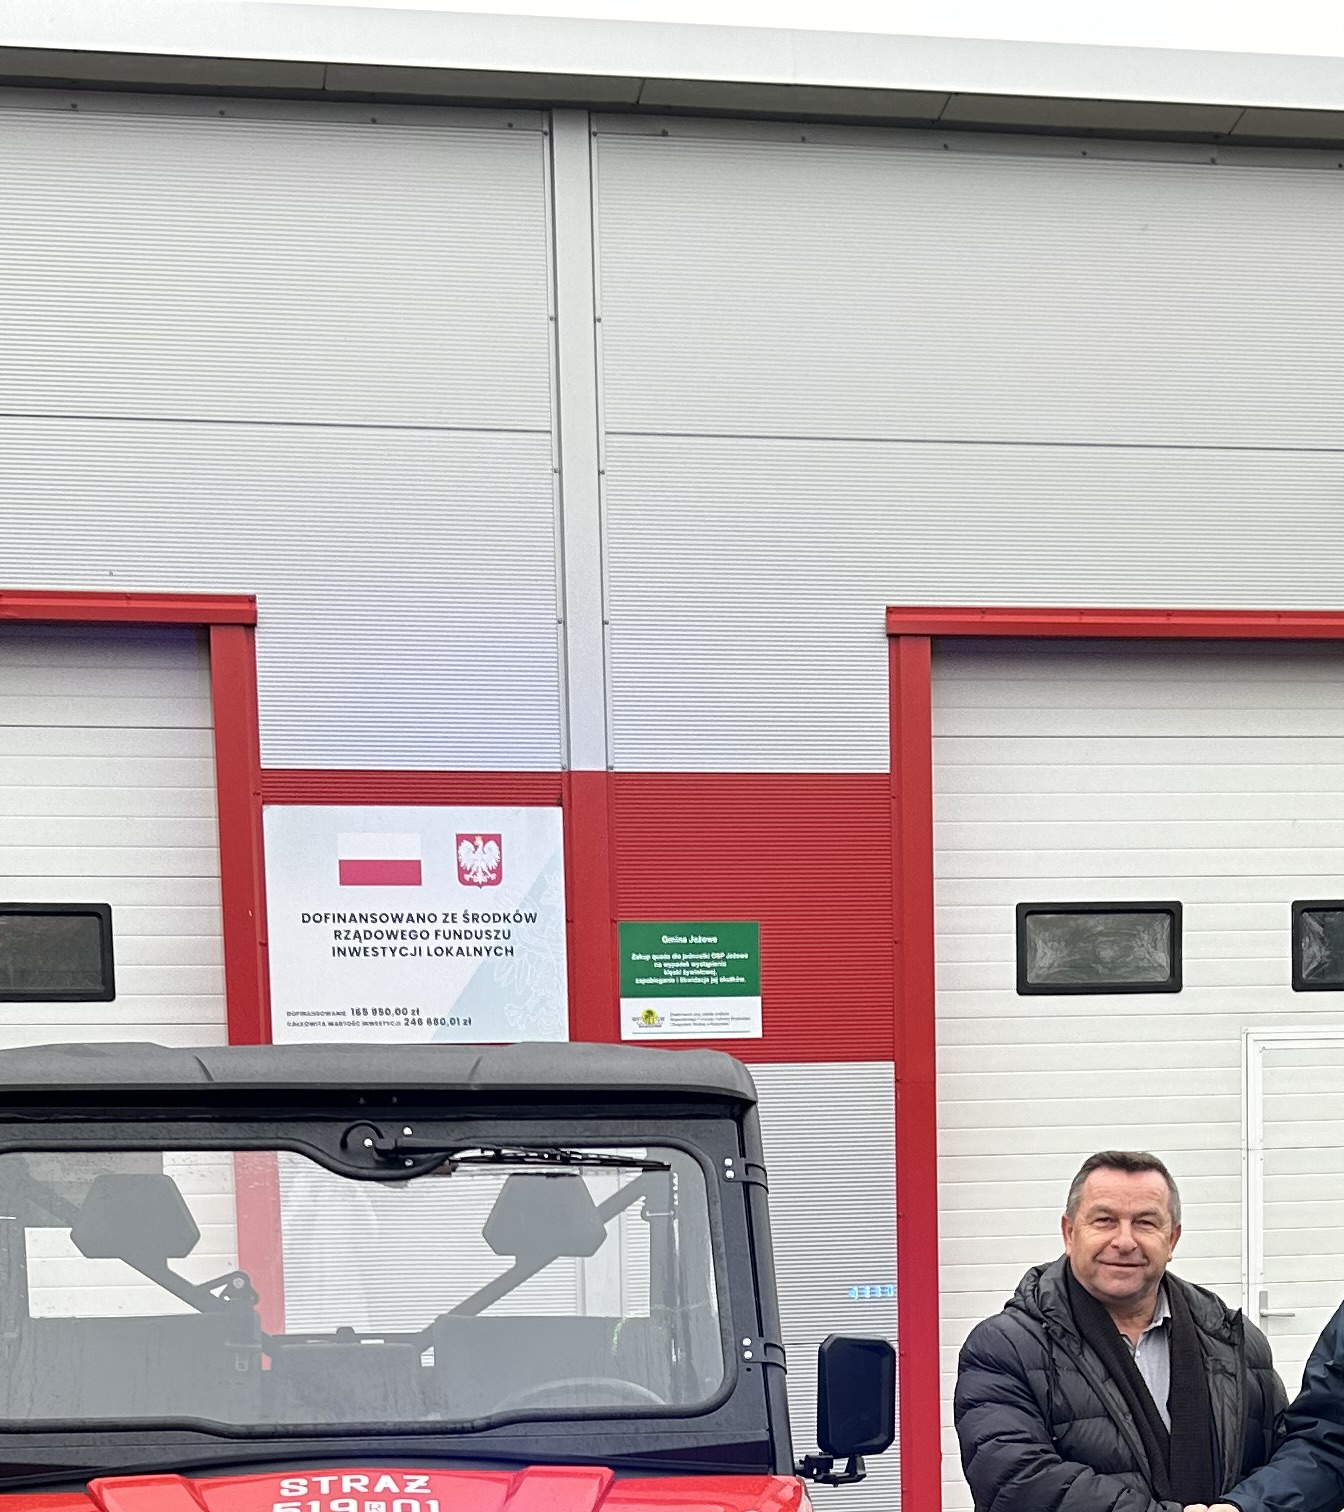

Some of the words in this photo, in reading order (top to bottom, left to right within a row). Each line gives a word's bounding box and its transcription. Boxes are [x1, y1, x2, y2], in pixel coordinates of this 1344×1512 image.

[301, 912, 439, 924] DOFINANSOWANO
[442, 912, 458, 924] ZE
[462, 909, 538, 924] ŚRODKÓW
[333, 929, 431, 943] RZĄDOWEGO
[434, 929, 512, 941] FUNDUSZU
[331, 946, 422, 958] INWESTYCJI
[426, 946, 515, 958] LOKALNYCH
